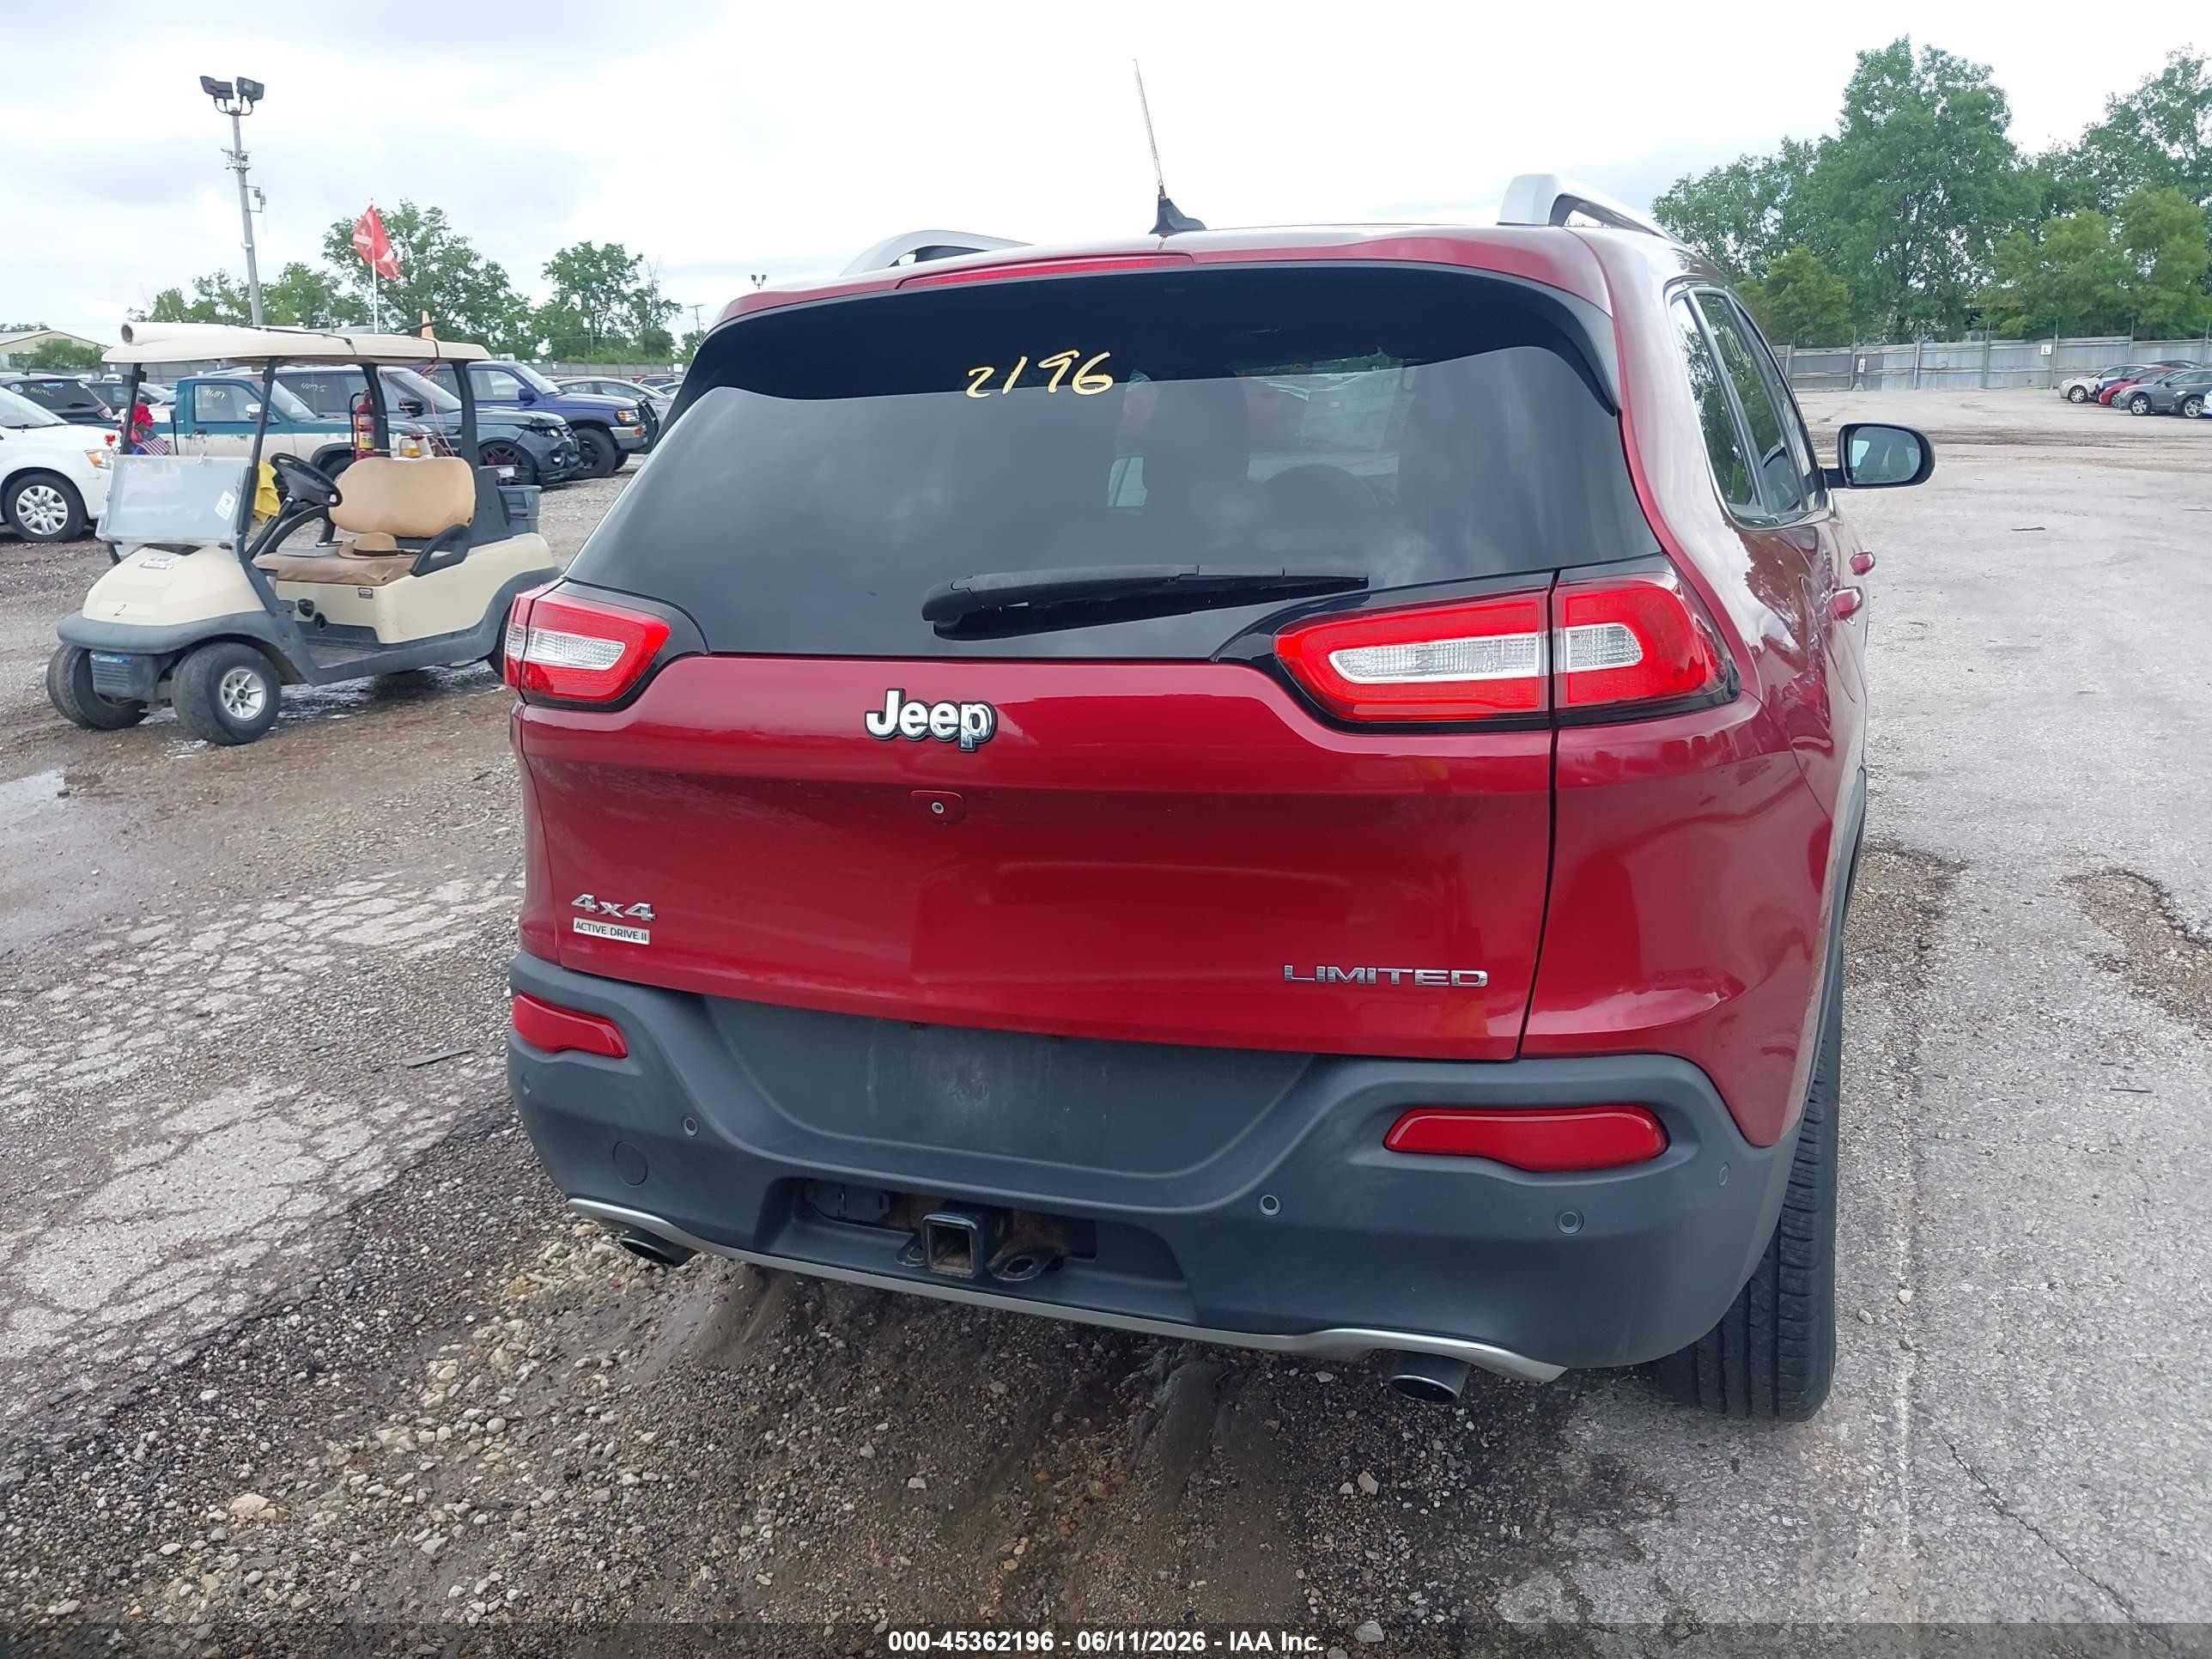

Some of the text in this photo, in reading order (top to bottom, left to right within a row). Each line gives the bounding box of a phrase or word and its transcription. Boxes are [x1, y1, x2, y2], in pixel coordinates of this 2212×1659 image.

[966, 349, 1114, 398] 2196
[865, 688, 997, 752] Jeep
[570, 893, 657, 921] 4x4
[575, 921, 647, 942] ACTIVE DRIVE II
[1284, 964, 1489, 987] LIMITED
